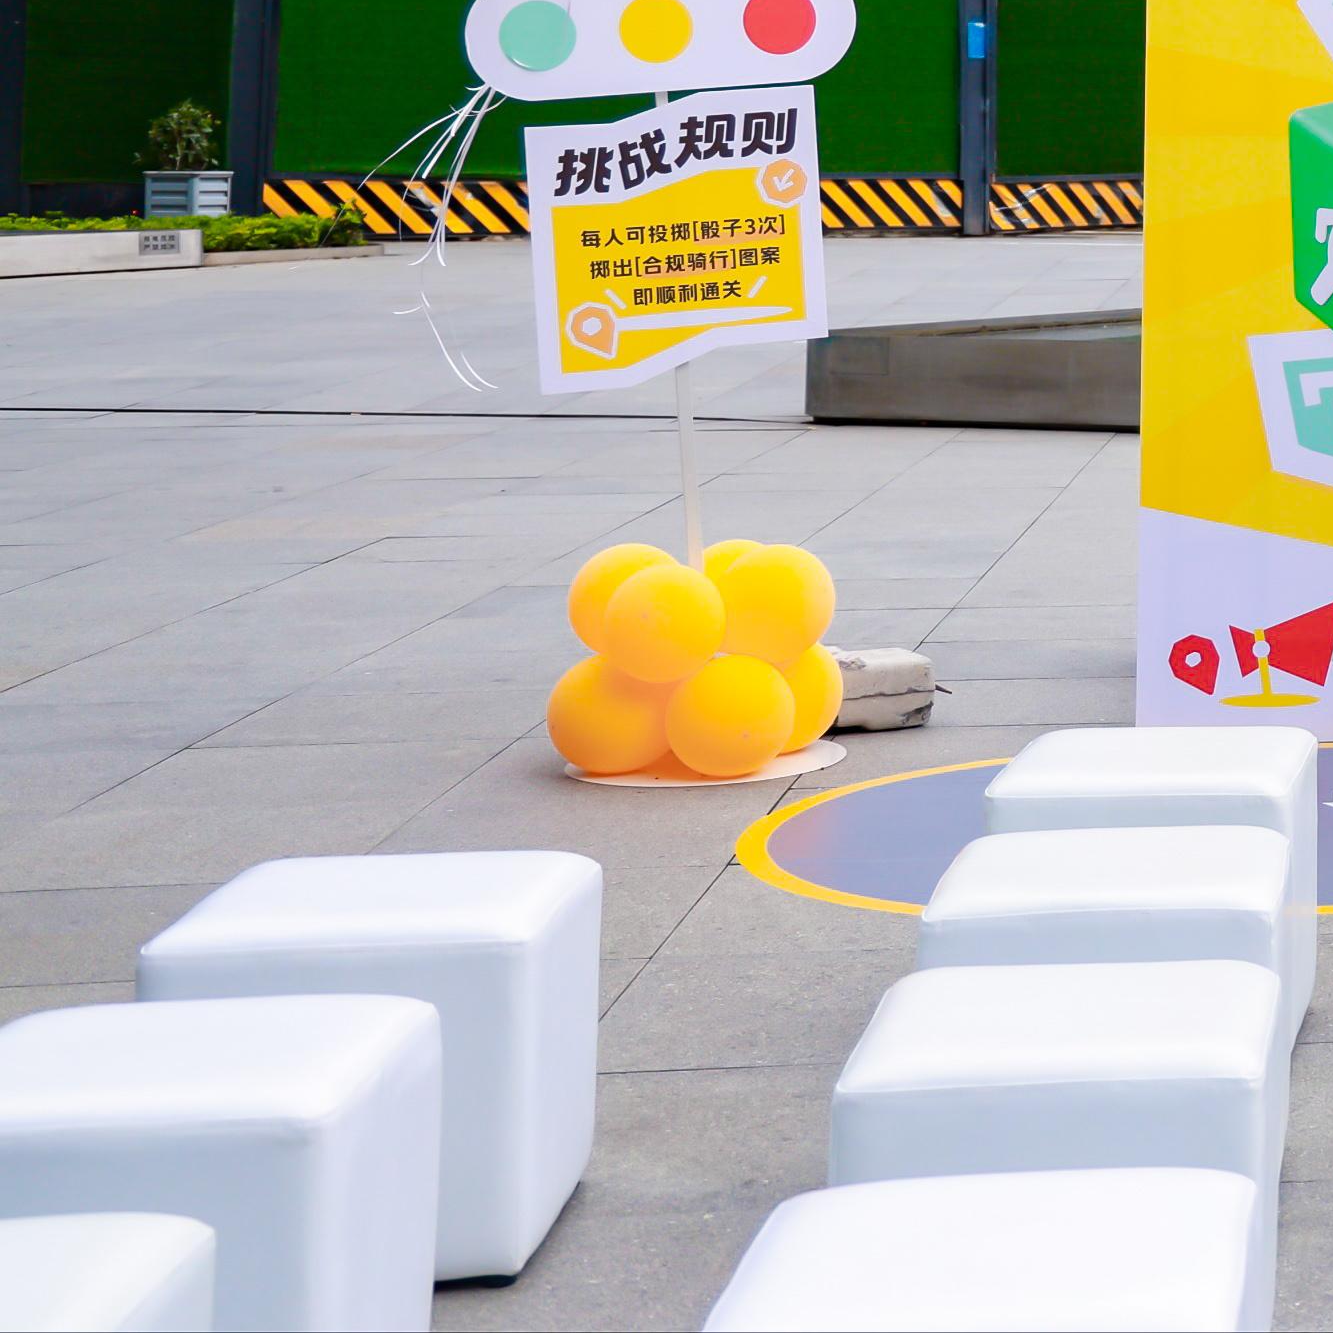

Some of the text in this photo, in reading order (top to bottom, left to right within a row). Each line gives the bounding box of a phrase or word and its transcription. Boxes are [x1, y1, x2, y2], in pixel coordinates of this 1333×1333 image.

[553, 106, 798, 197] 挑战规则
[580, 213, 786, 248] 每人可投掷[骰子3次]
[589, 247, 782, 279] 掷出[合规骑行]图案
[632, 280, 743, 306] 即顺利通关
